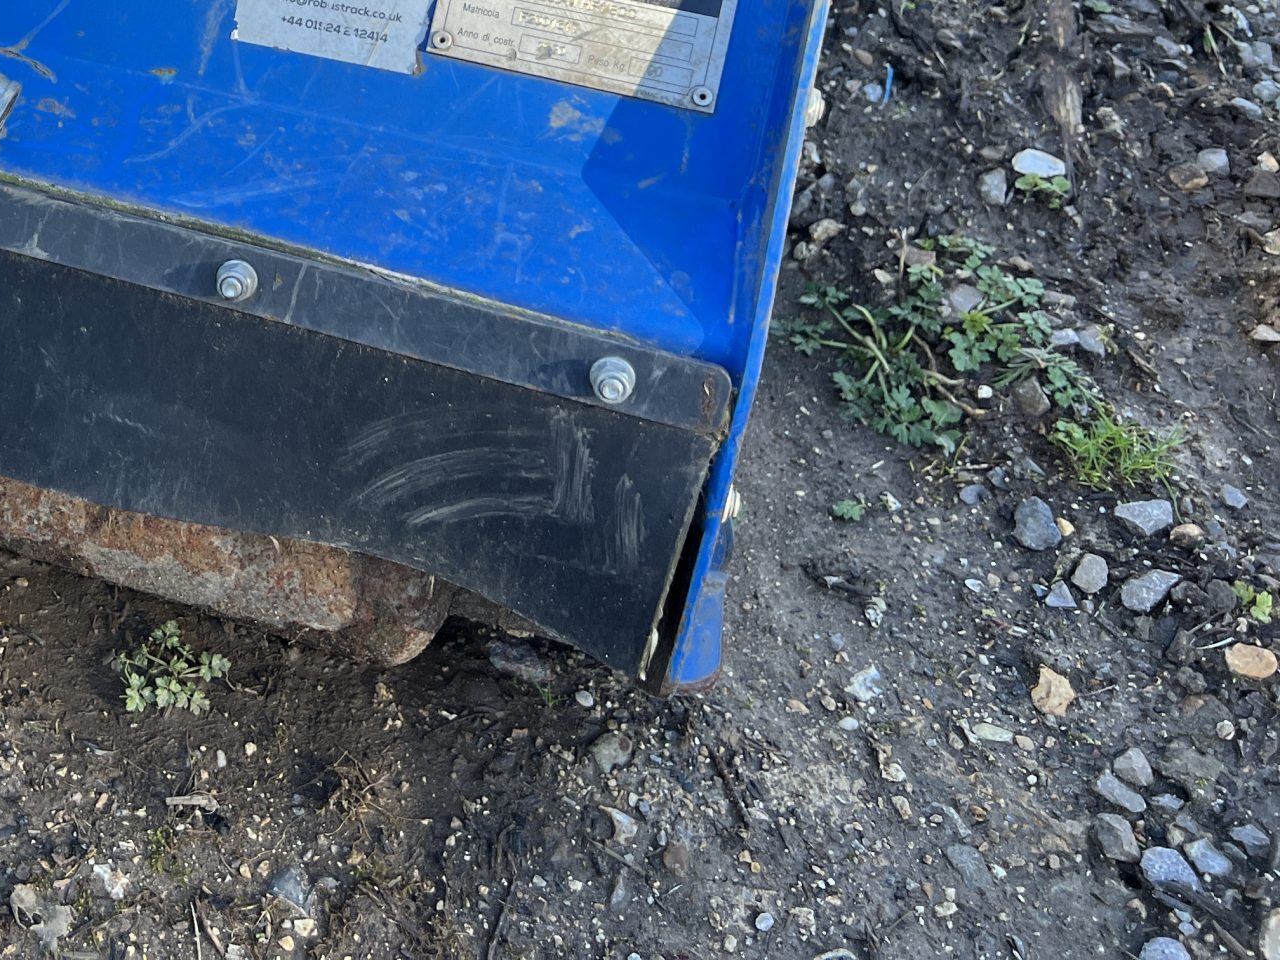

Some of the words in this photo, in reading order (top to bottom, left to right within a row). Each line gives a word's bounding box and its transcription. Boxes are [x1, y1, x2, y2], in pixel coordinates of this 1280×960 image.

[462, 2, 500, 19] Matricola
[281, 16, 303, 28] +44
[457, 26, 480, 39] Anno
[481, 31, 492, 42] di
[587, 55, 609, 67] Peso
